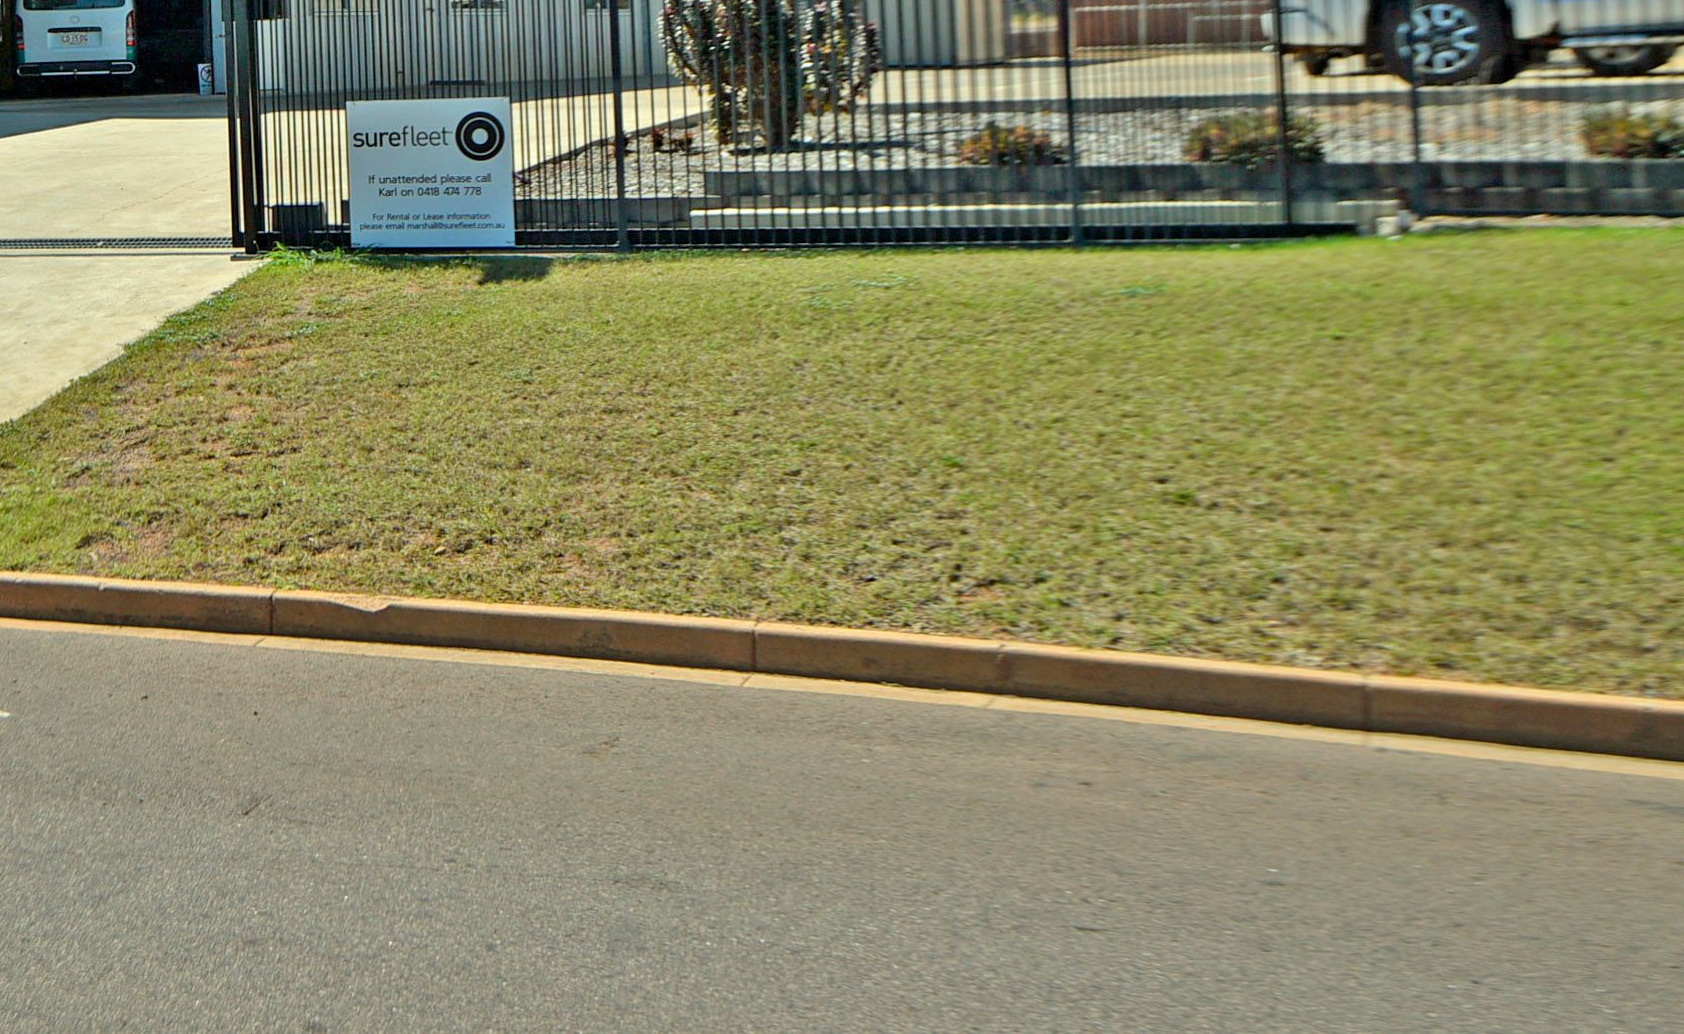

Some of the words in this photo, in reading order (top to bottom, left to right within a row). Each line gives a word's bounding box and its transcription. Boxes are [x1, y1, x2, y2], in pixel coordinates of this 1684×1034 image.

[353, 126, 452, 147] surefleet
[368, 175, 376, 184] If
[379, 174, 437, 184] unattended
[440, 174, 472, 185] please
[475, 173, 492, 183] call
[378, 187, 397, 197] Karl
[401, 189, 414, 197] on
[417, 187, 440, 196] 0418
[464, 186, 482, 196] 778
[372, 213, 384, 221] For
[387, 213, 409, 221] Rental
[423, 213, 444, 221] Lease
[447, 212, 491, 220] information
[360, 223, 383, 231] please
